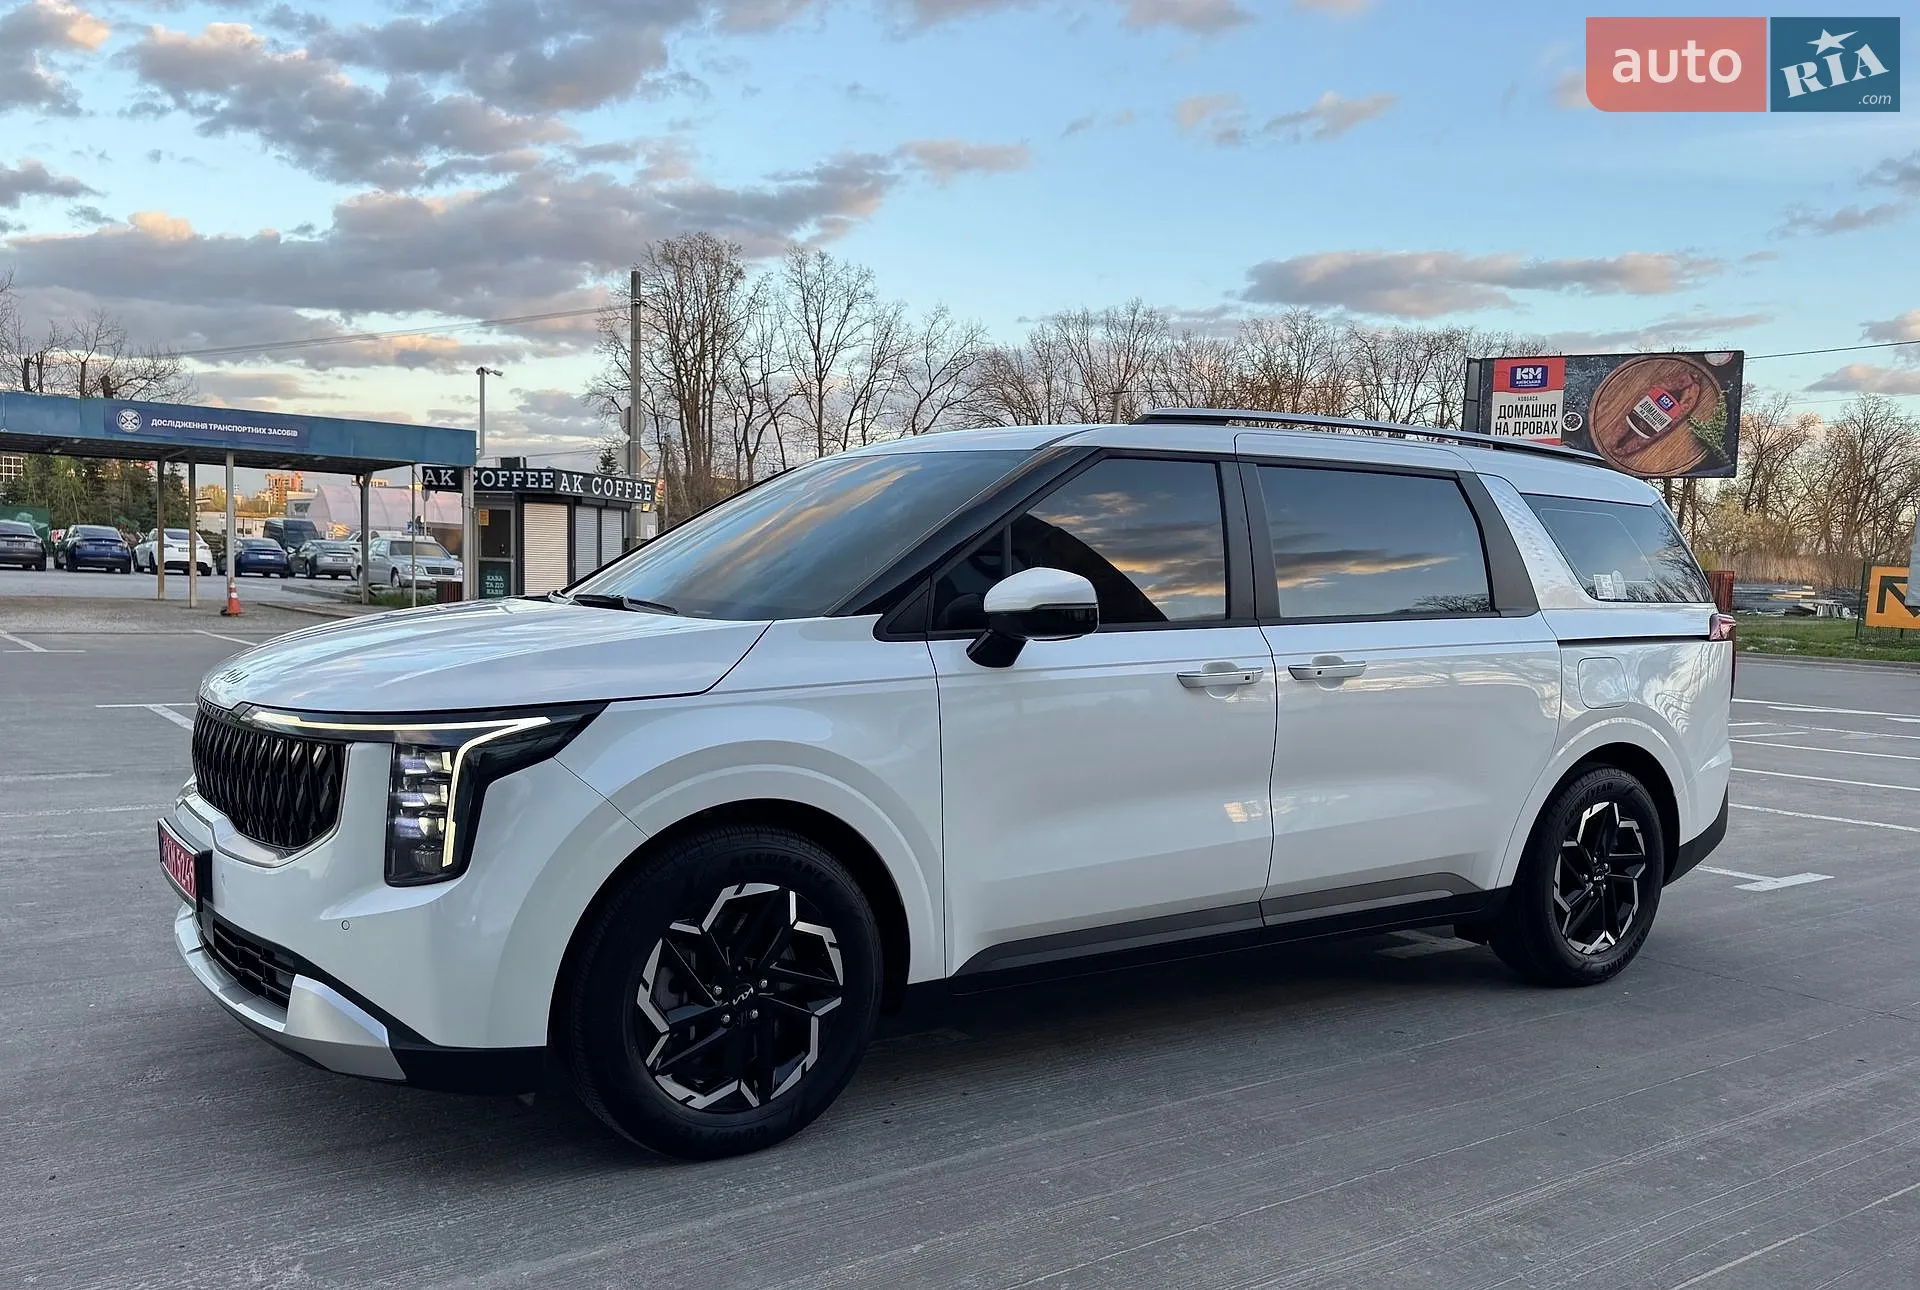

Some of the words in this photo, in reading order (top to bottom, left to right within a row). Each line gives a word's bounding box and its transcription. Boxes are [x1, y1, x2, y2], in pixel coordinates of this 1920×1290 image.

[1516, 367, 1542, 380] КМ
[1497, 404, 1557, 420] ДОМАШНЯ
[1639, 401, 1668, 426] ДОМАШНЯ
[151, 418, 208, 430] ДОСЛІДЖЕННЯ
[209, 423, 267, 435] ТРАНСПОРТНИХ
[267, 428, 298, 437] ЗАСОБІВ
[1495, 421, 1509, 436] НА
[1512, 421, 1558, 436] ДРОВАХ
[423, 469, 455, 486] AK
[559, 473, 584, 493] AK
[592, 476, 652, 502] COFFEE
